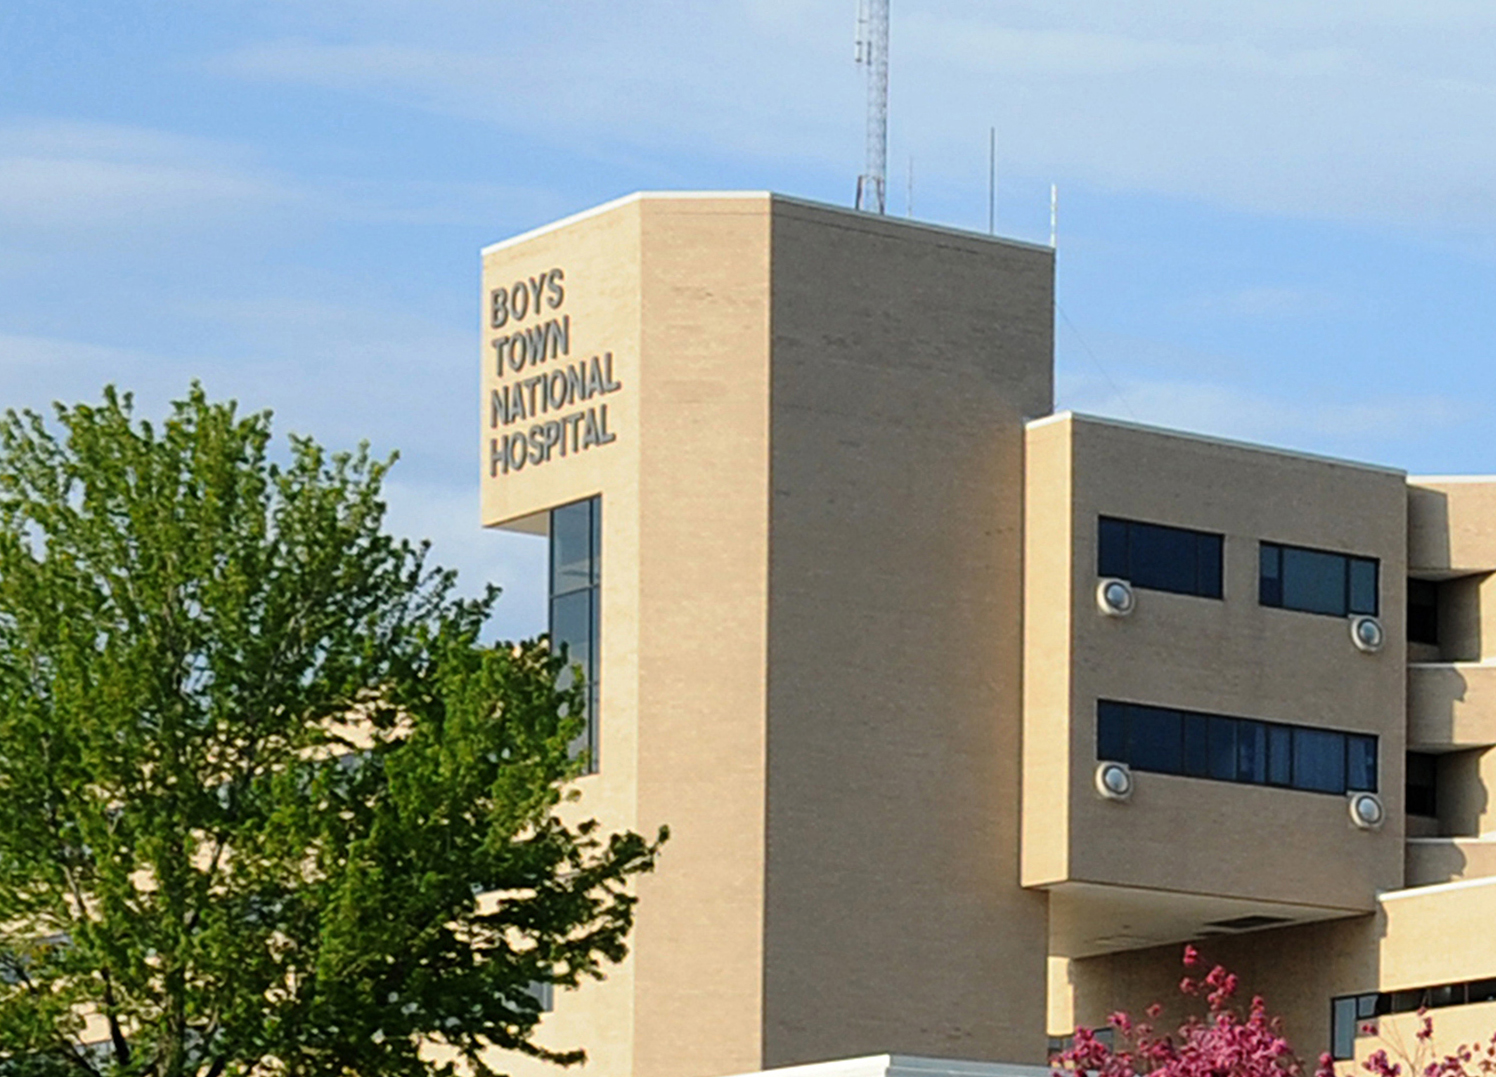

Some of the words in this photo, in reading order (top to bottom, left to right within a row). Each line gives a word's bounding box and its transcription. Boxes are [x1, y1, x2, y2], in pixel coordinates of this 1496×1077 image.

[490, 268, 565, 329] BOYS
[491, 314, 570, 378] TOWN
[490, 351, 622, 429] NATIONAL
[490, 403, 617, 478] HOSPITAL
